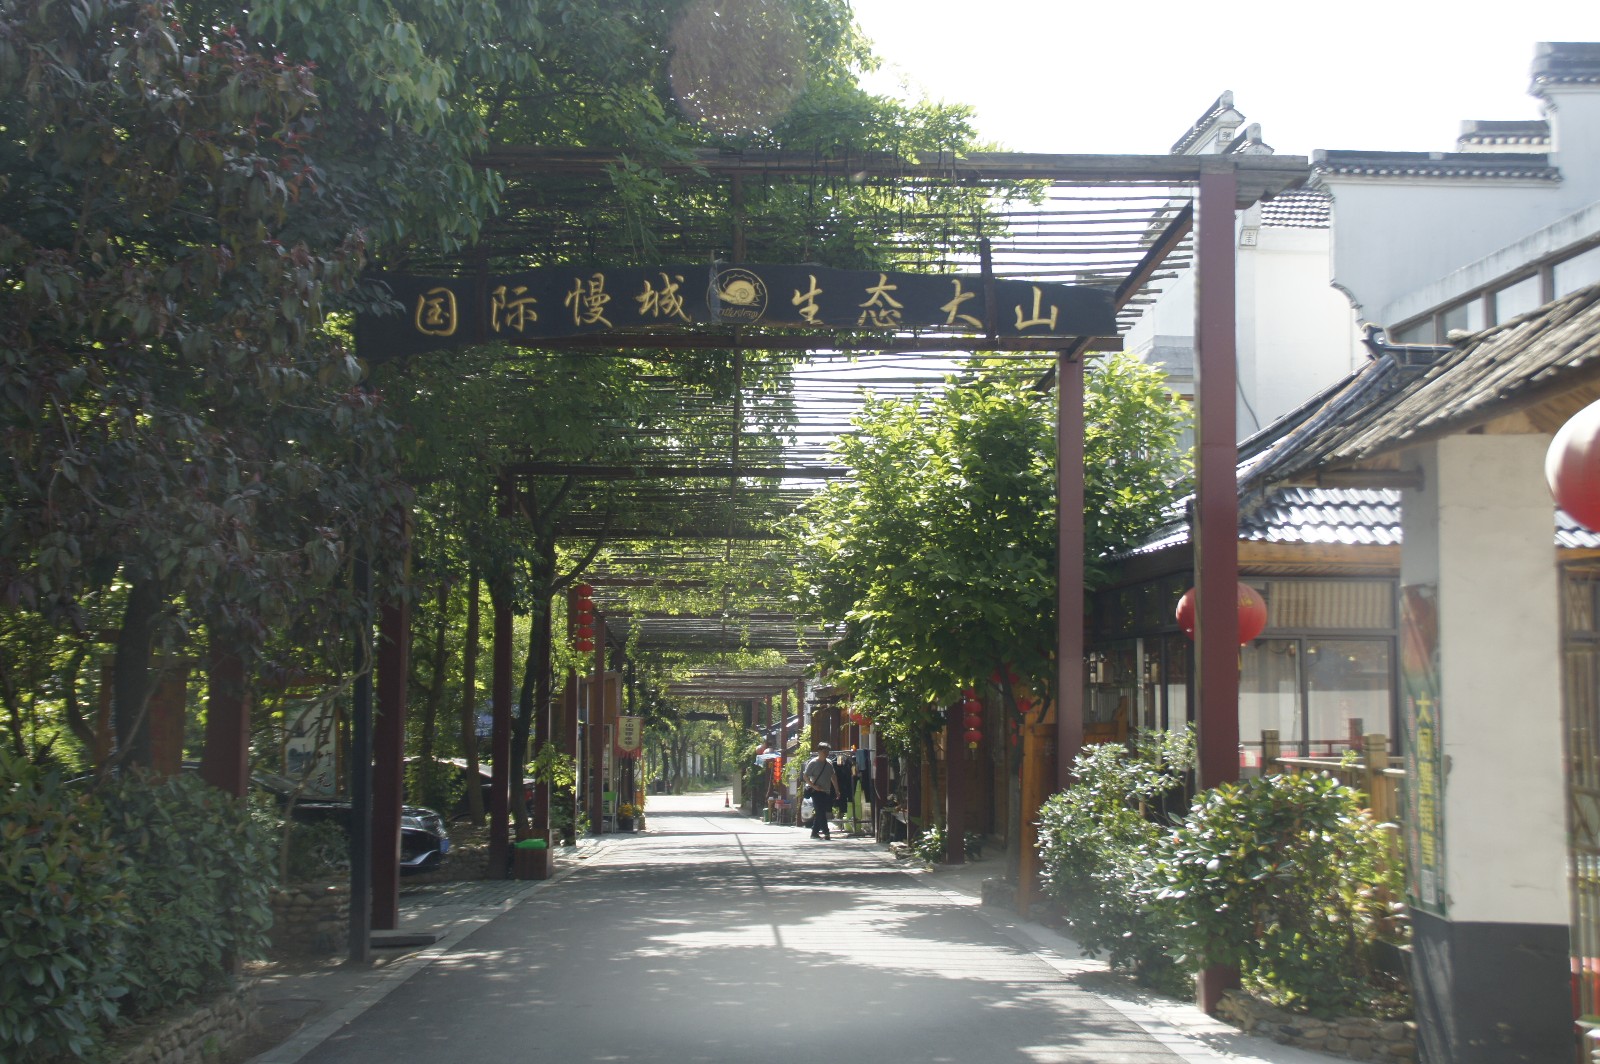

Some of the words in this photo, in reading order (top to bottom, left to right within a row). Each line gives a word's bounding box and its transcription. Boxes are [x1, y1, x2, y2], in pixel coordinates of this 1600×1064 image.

[415, 272, 692, 337] 国际慢城
[792, 273, 1059, 331] 生态大山
